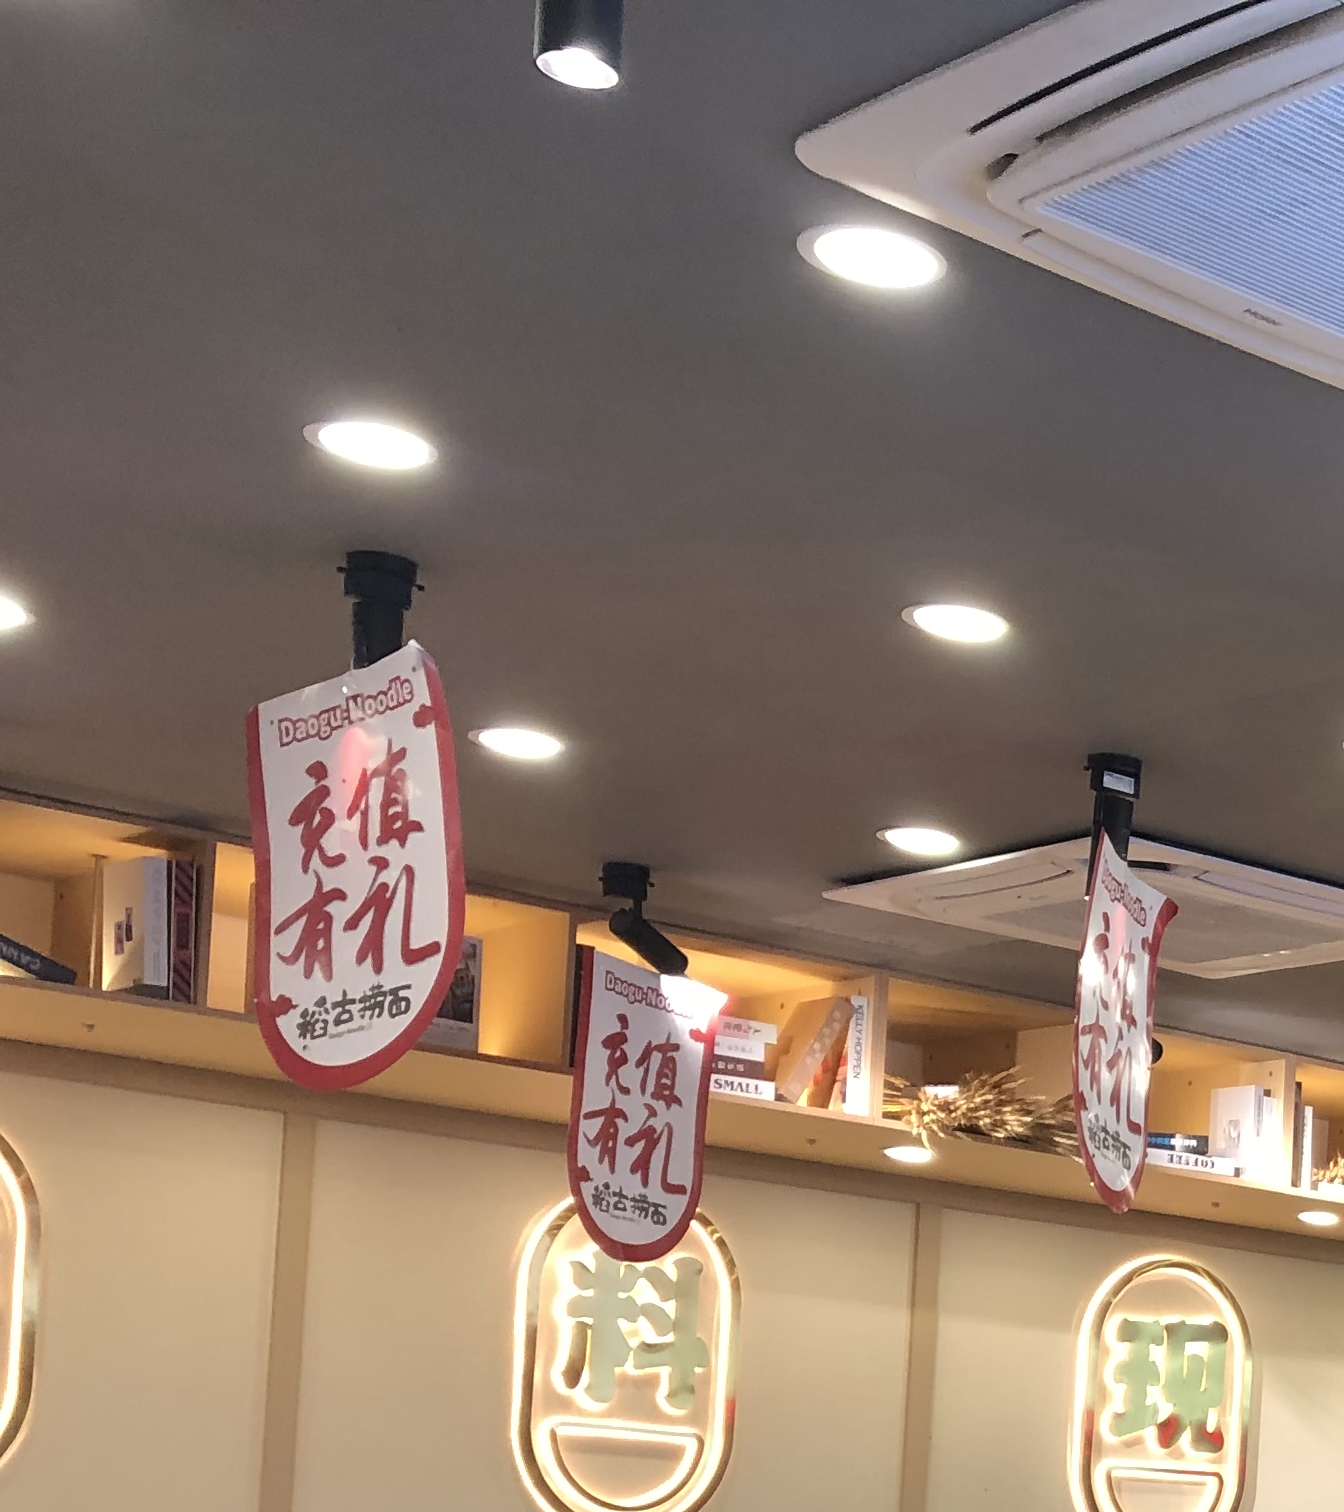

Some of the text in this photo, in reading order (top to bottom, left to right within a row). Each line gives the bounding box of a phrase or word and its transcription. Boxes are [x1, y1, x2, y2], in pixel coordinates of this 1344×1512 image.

[288, 739, 425, 872] 充值
[274, 856, 441, 983] 有礼
[297, 981, 412, 1041] 稻古捞面
[853, 1037, 863, 1080] HOPPEN
[601, 1013, 682, 1110] 充值
[713, 1077, 763, 1096] SMALL
[583, 1087, 688, 1195] 有礼
[1167, 1153, 1216, 1171] COFFEE
[591, 1182, 668, 1227] 稻古捞面
[561, 1249, 710, 1410] 料
[1109, 1318, 1228, 1454] 现
